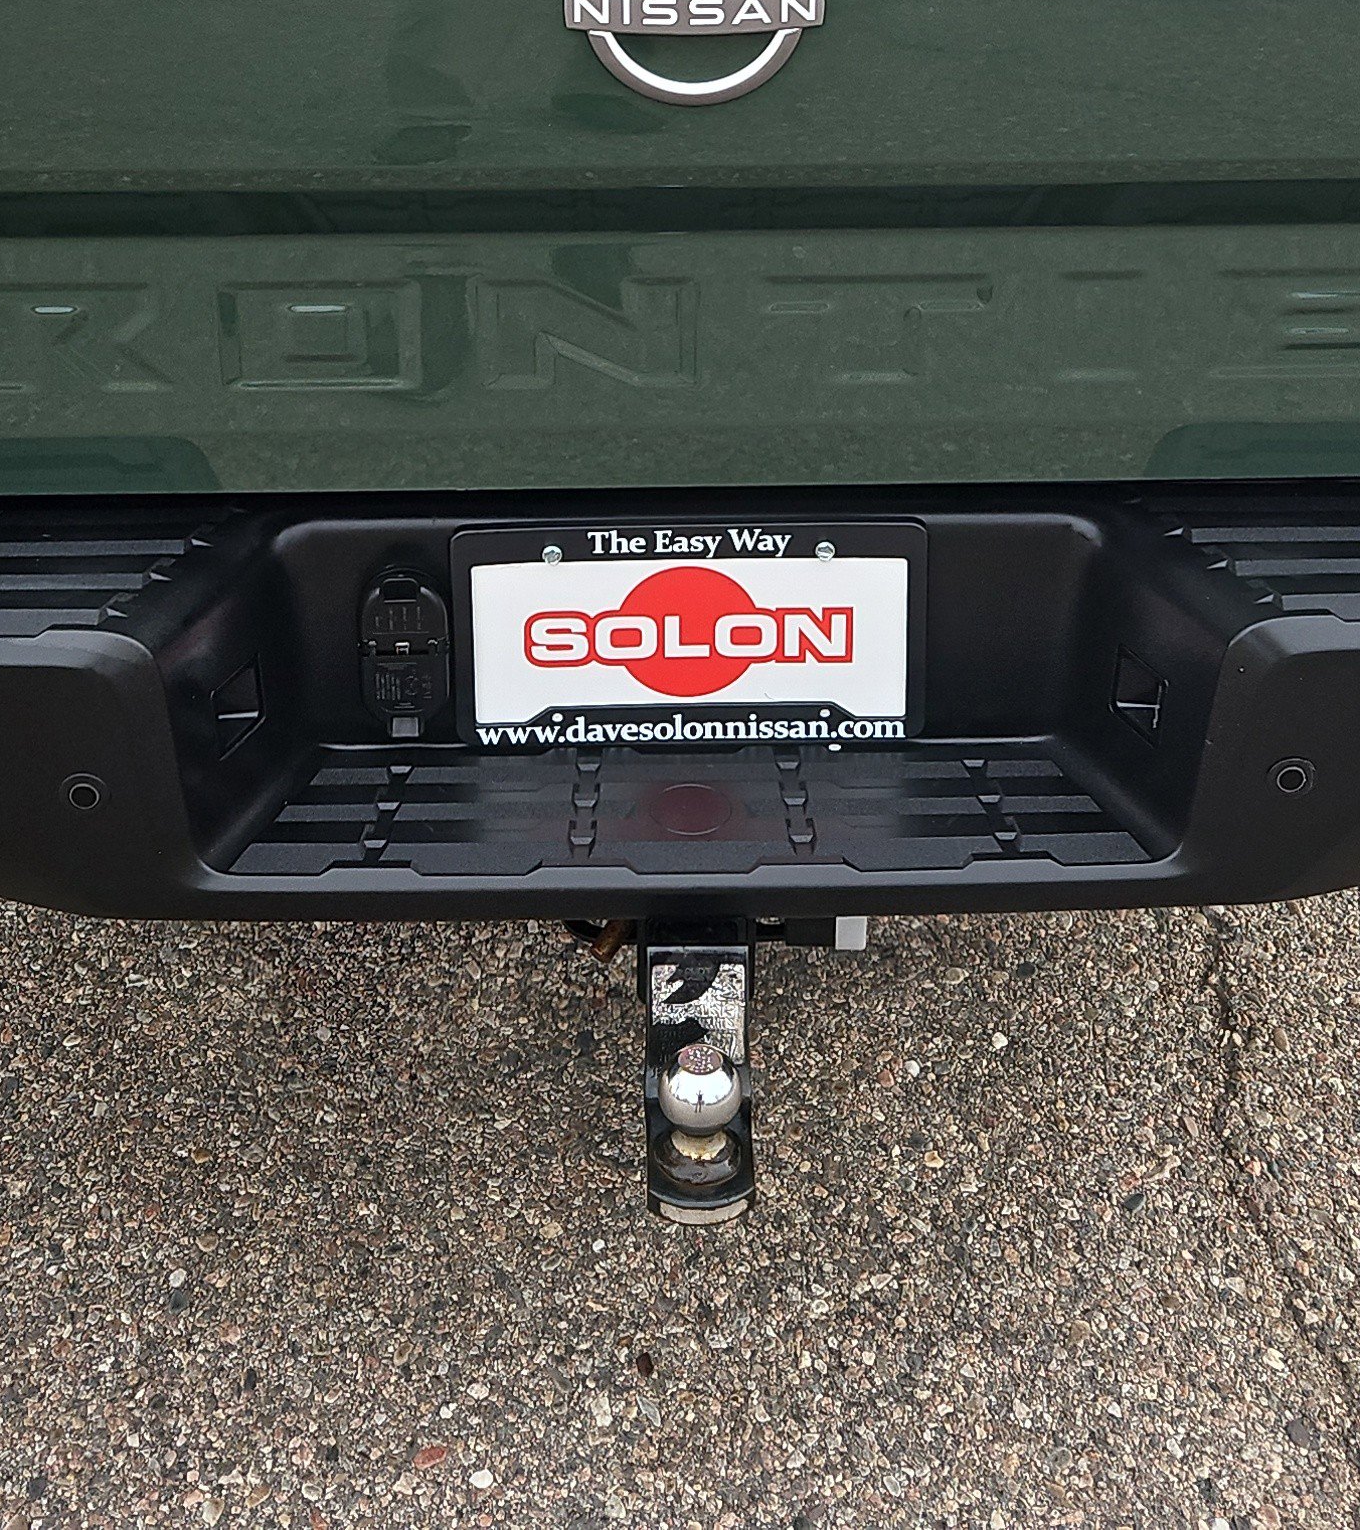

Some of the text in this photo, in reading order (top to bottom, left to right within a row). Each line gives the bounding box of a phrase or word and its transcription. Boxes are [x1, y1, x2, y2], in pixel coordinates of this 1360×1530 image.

[587, 528, 791, 558] The Easy Way
[524, 606, 854, 668] SOLON
[476, 714, 906, 745] www.davesolonnissan.com
